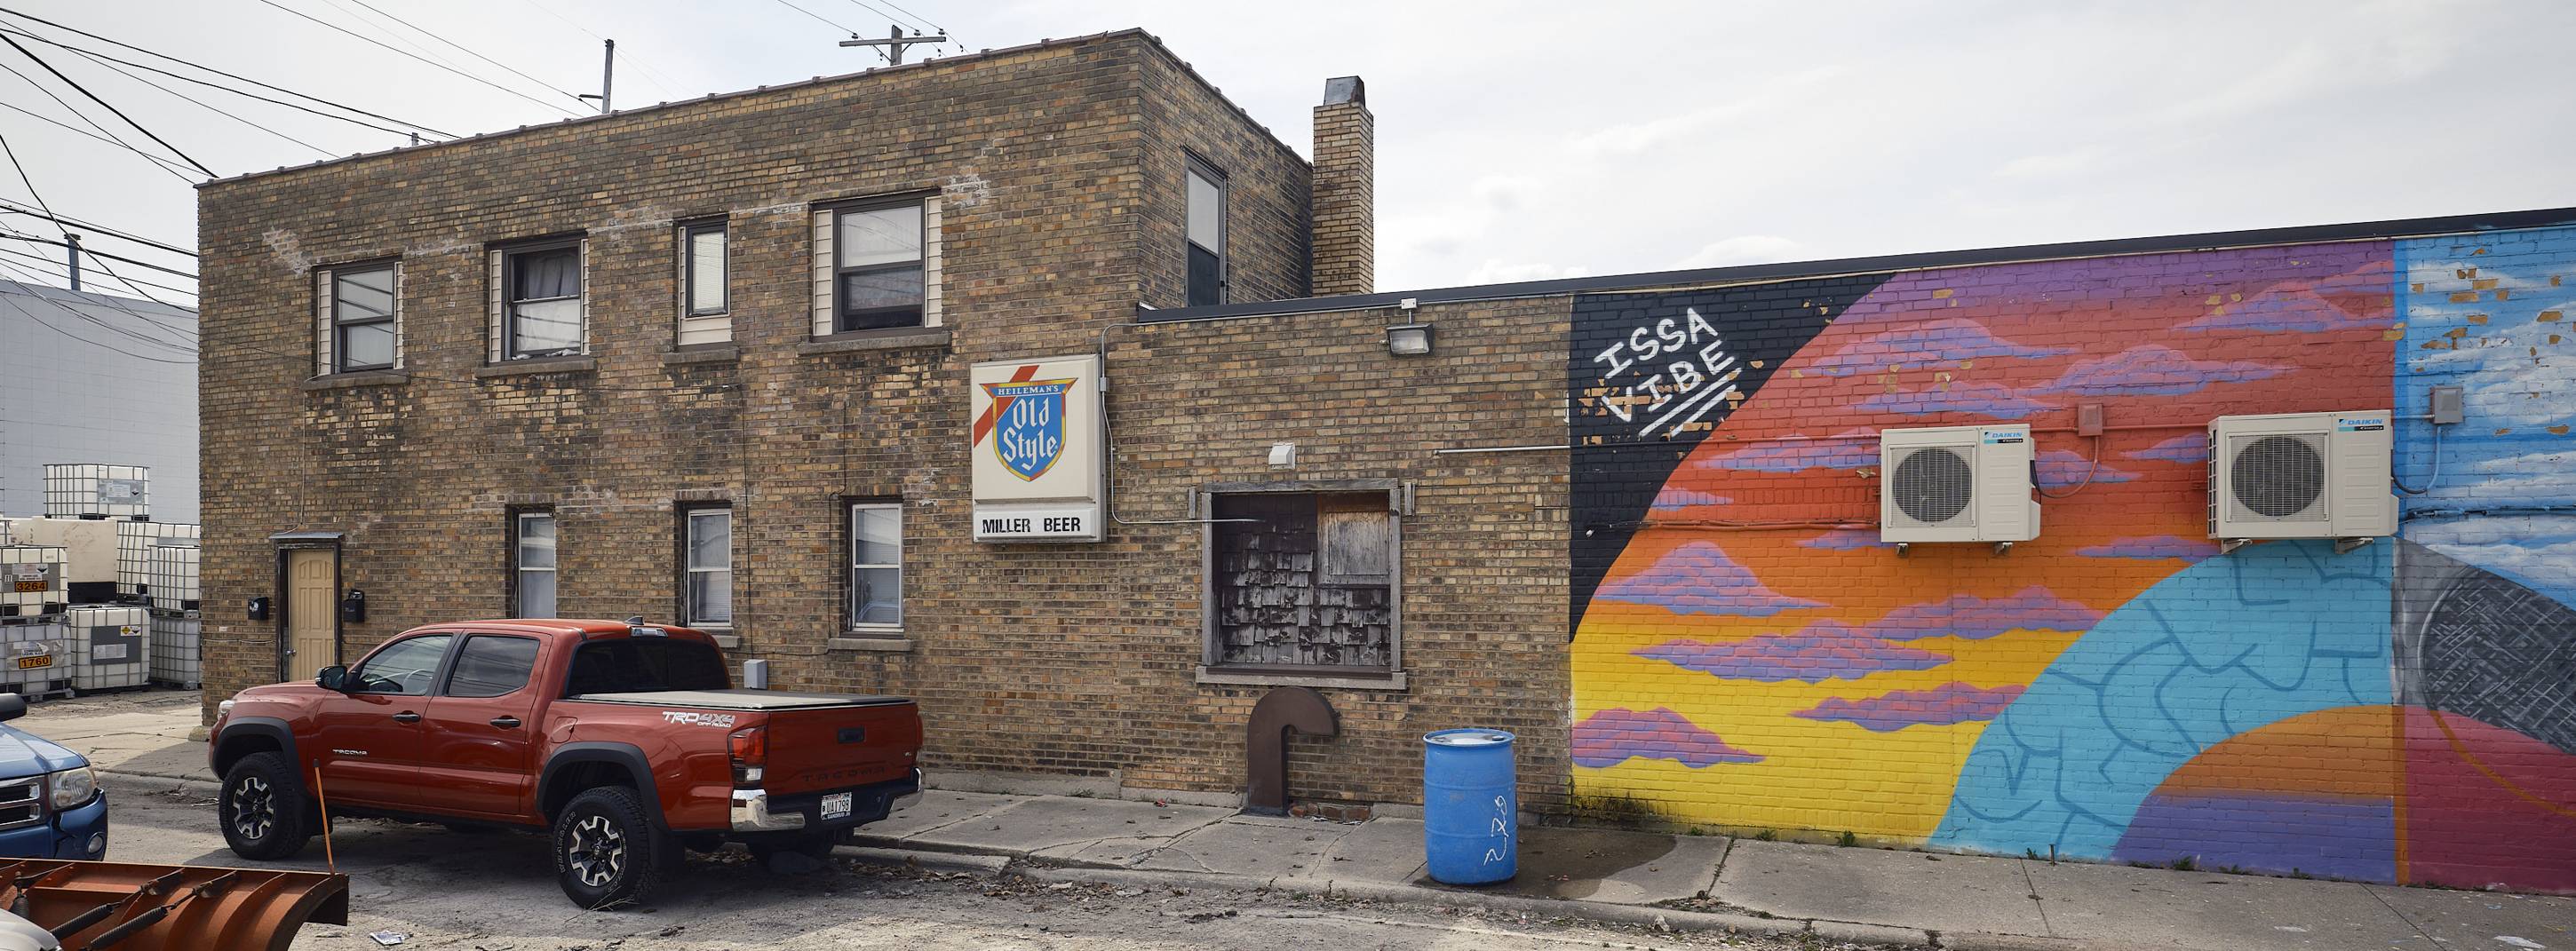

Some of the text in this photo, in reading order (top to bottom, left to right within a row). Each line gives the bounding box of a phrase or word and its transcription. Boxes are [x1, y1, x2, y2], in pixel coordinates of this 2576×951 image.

[1594, 307, 1719, 379] ISSA
[998, 384, 1059, 395] HEILEMAN'S
[1601, 339, 1735, 423] VIBE
[1013, 398, 1049, 430] Old
[1003, 426, 1058, 471] Style
[982, 517, 1081, 534] MILLER BEER
[17, 582, 45, 590] 3264
[21, 656, 49, 668] 1760
[662, 710, 700, 725] TRD
